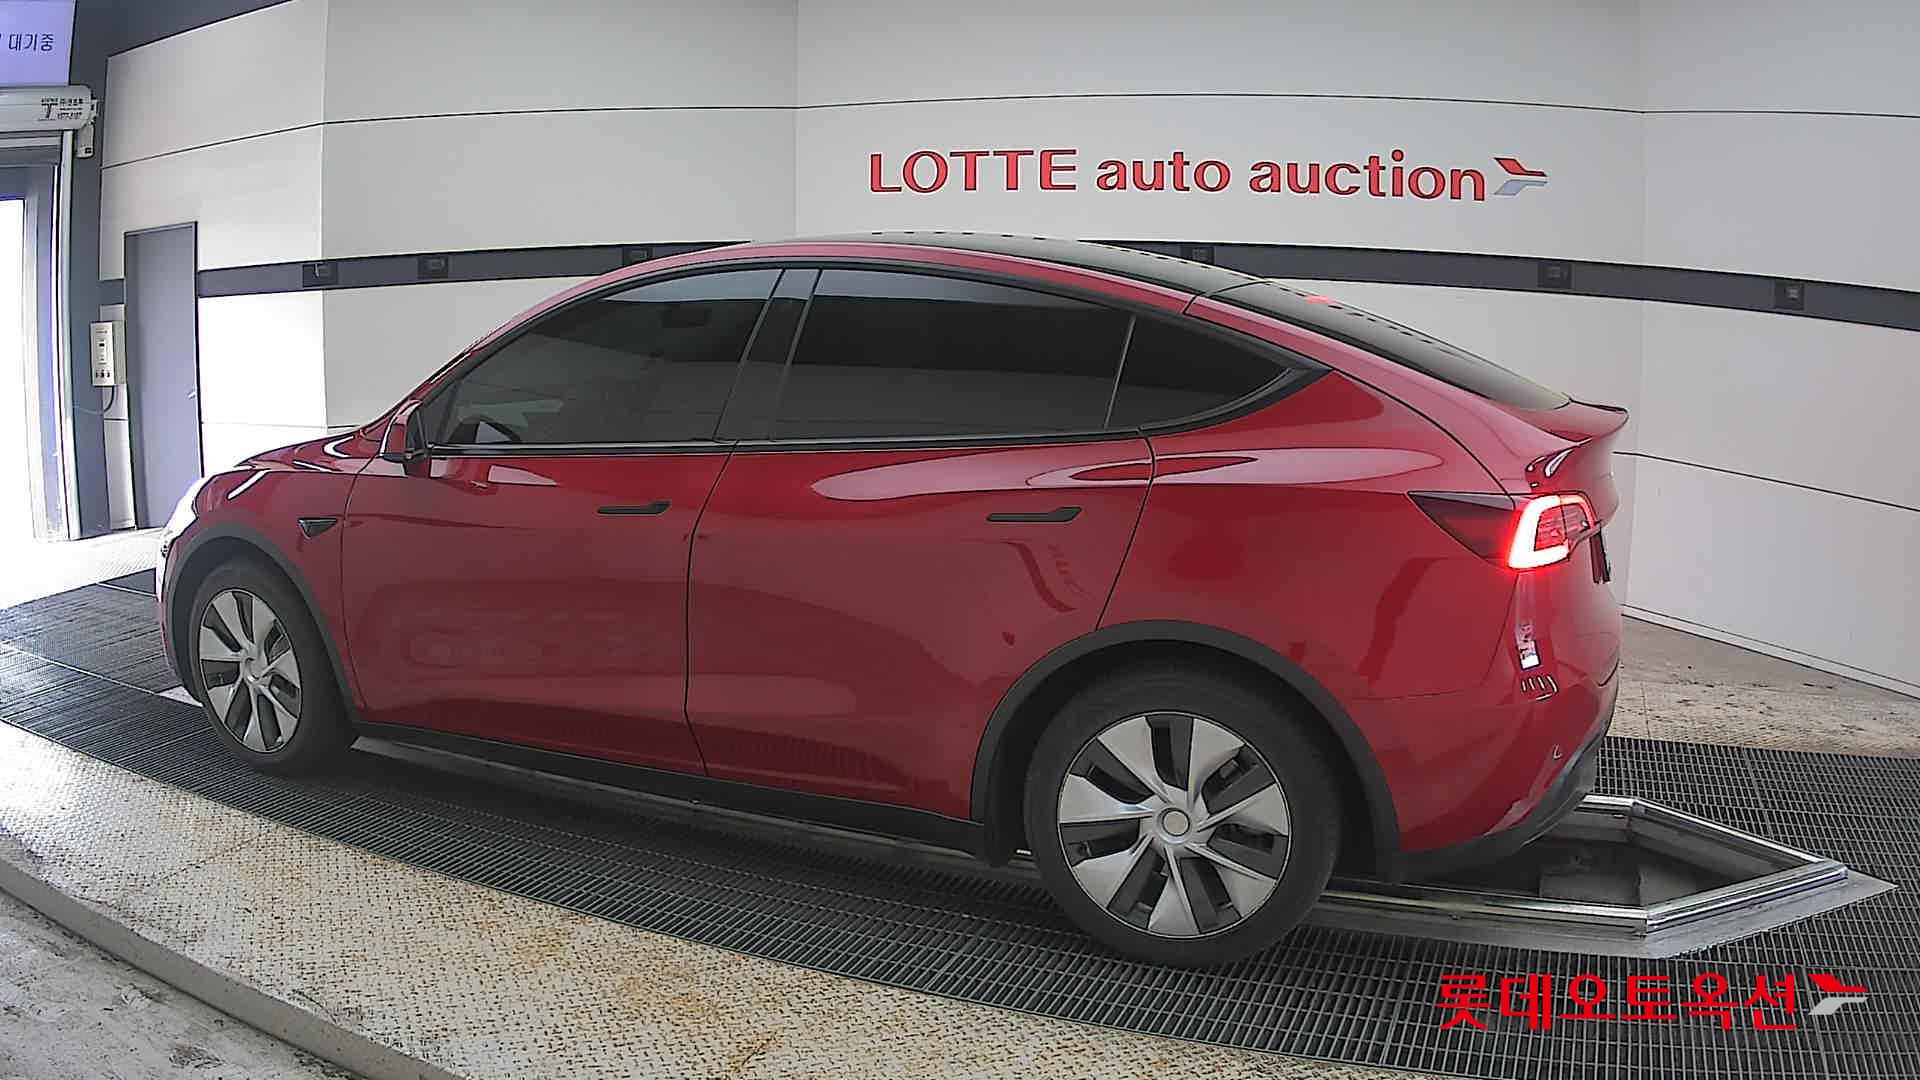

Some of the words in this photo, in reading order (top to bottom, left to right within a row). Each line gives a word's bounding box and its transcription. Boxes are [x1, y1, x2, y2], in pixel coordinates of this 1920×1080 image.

[8, 33, 54, 52] 대기중
[868, 149, 1078, 194] LOTTE
[1096, 150, 1232, 194] auto
[1249, 149, 1487, 202] auction
